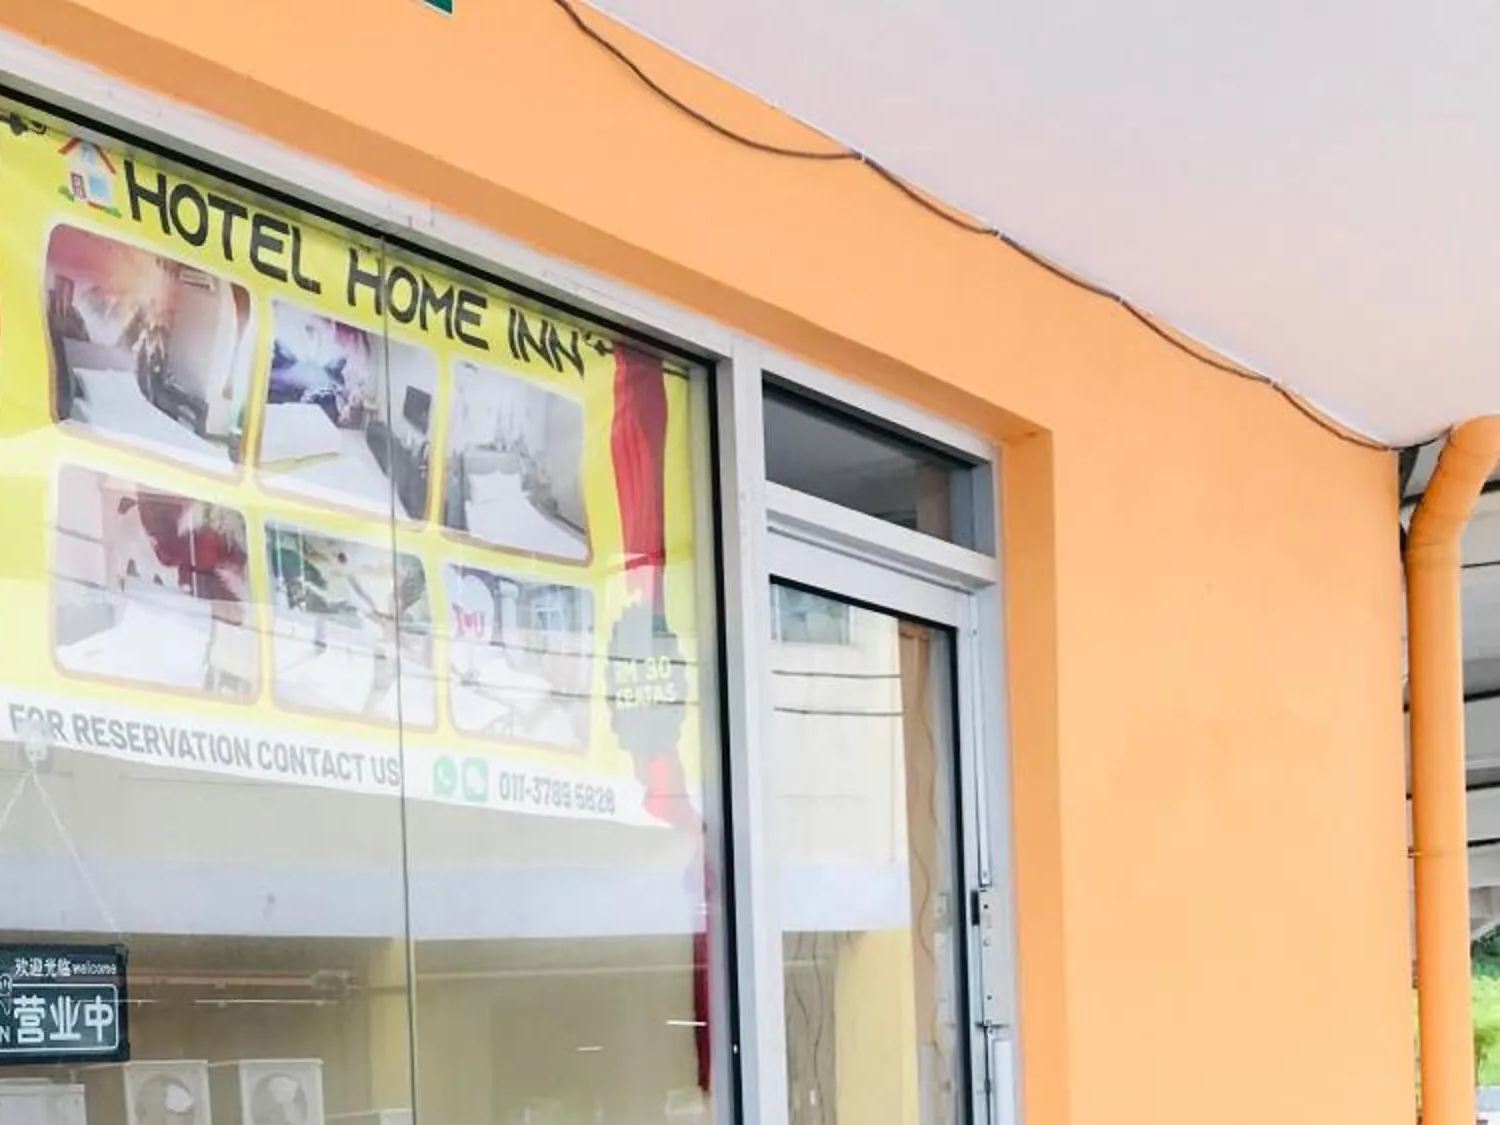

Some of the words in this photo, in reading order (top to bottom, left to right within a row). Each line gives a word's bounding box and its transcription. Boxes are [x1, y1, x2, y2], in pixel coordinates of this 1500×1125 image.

[124, 160, 321, 294] HOTEL
[347, 248, 489, 350] HOME
[508, 307, 585, 377] INN
[72, 712, 253, 768] RESERVATION
[257, 740, 364, 784] CONTACT
[371, 757, 400, 787] US
[72, 960, 116, 976] welcome
[13, 994, 114, 1043] 营业中
